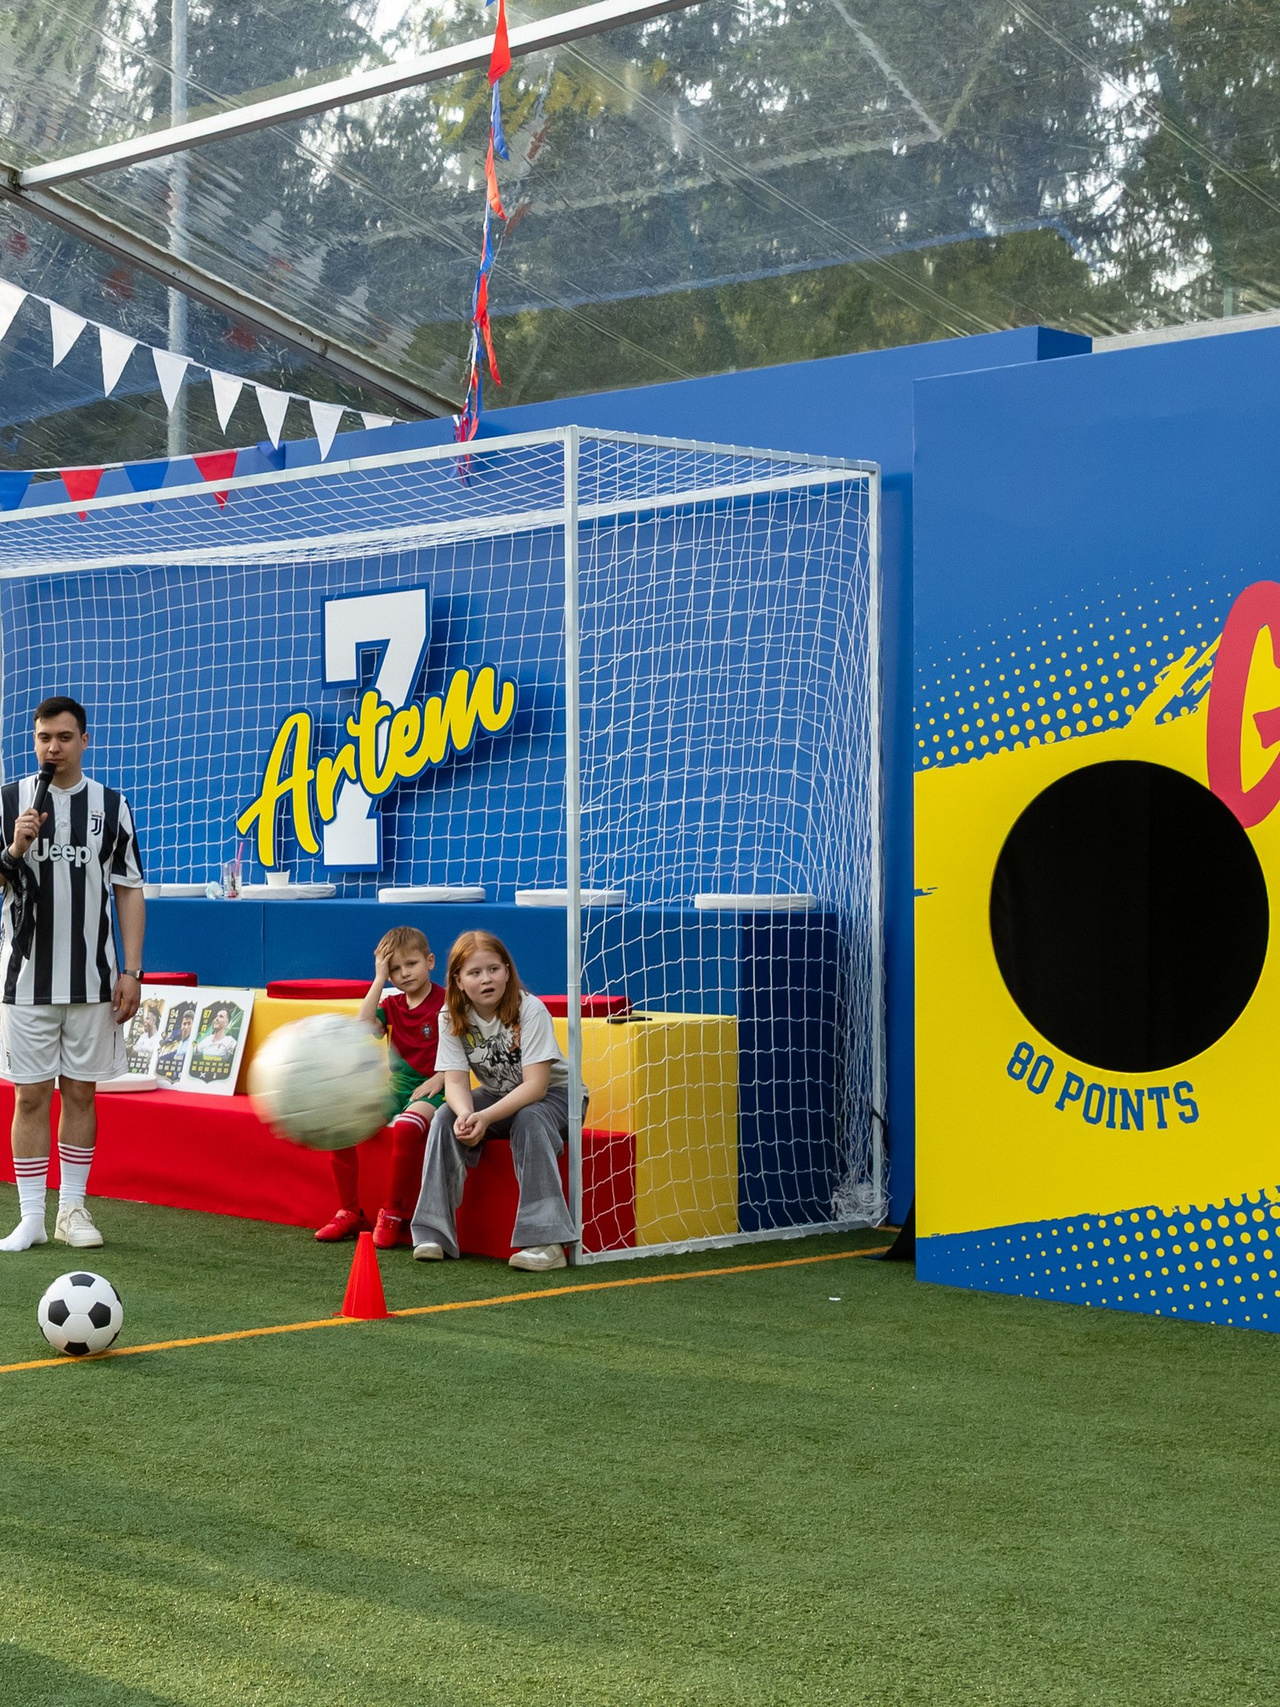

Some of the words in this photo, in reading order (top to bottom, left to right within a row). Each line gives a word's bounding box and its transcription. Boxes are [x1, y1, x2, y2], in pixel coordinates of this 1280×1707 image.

[236, 667, 515, 866] Artem
[324, 588, 427, 866] 7
[31, 838, 93, 868] Jeep
[1006, 1041, 1055, 1095] 80
[1054, 1070, 1200, 1131] POINTS
